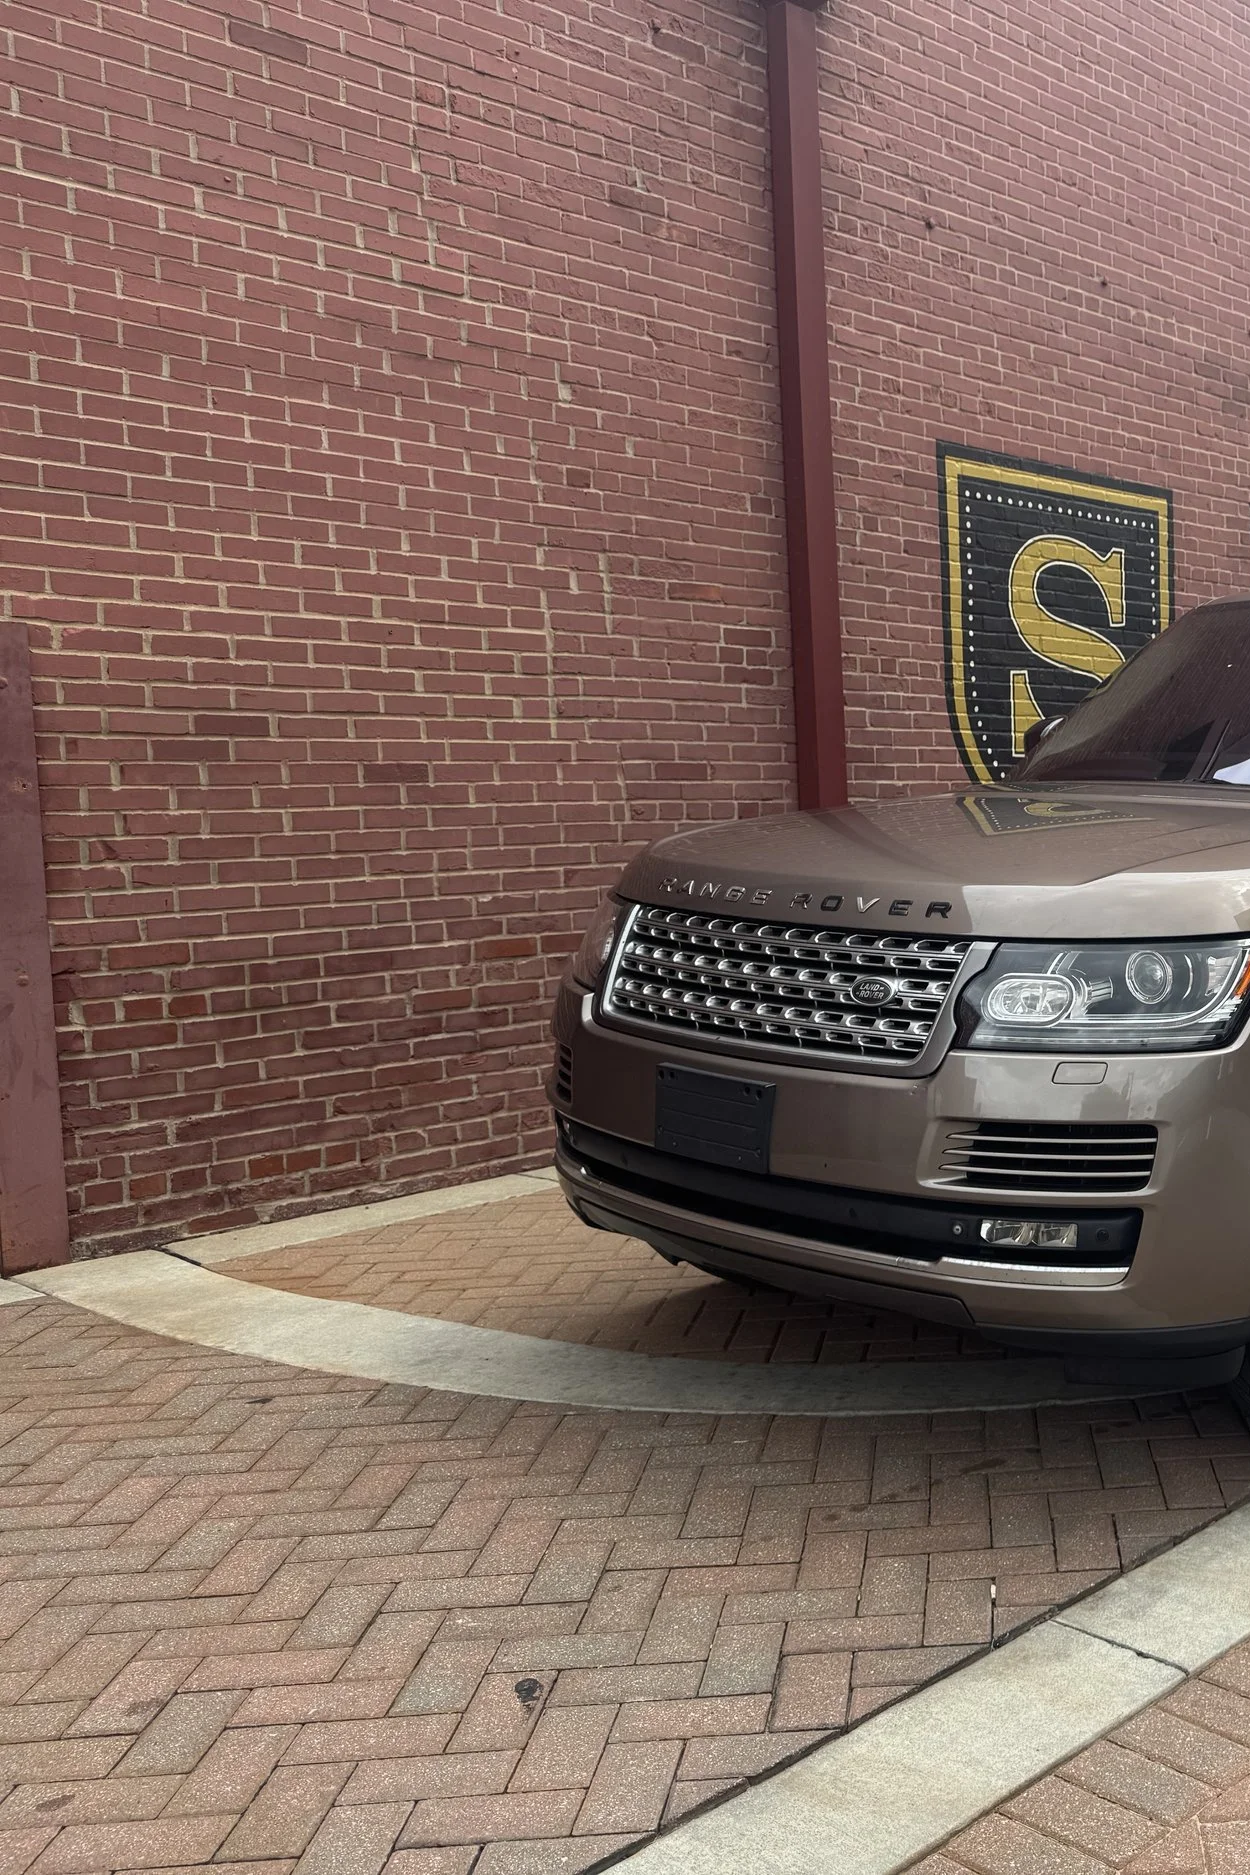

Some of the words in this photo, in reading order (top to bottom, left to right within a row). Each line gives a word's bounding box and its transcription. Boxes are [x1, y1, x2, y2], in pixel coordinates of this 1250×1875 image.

[1008, 533, 1126, 758] S
[658, 877, 773, 906] RANGE
[789, 892, 953, 919] ROVER
